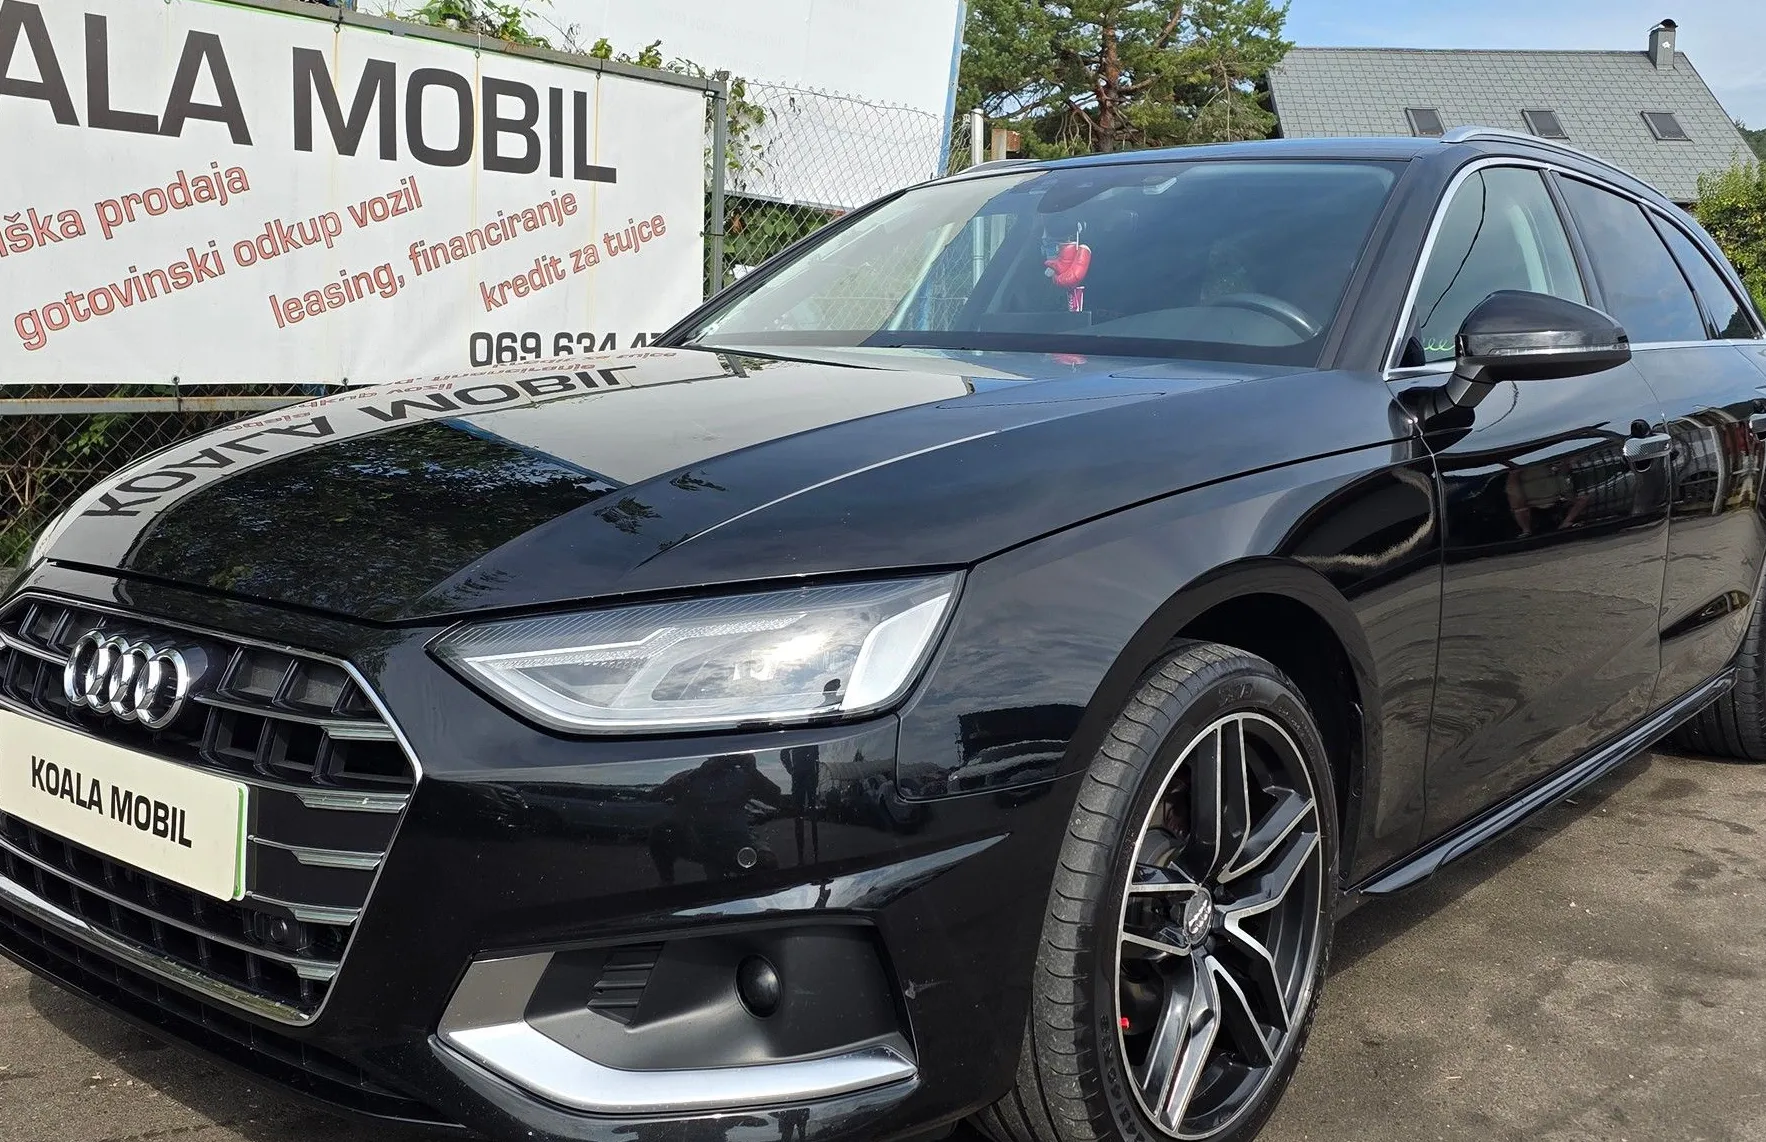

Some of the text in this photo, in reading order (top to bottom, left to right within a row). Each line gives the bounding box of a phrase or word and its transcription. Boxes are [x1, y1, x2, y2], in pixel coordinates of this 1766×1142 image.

[293, 46, 617, 184] MOBIL
[95, 161, 250, 239] prodaja
[14, 175, 423, 351] gotovinski odkup vozil
[269, 189, 578, 328] leasing, financiranje
[479, 212, 667, 312] kredit za tujce
[469, 331, 542, 367] 069
[31, 755, 192, 848] KOALA MOBIL
